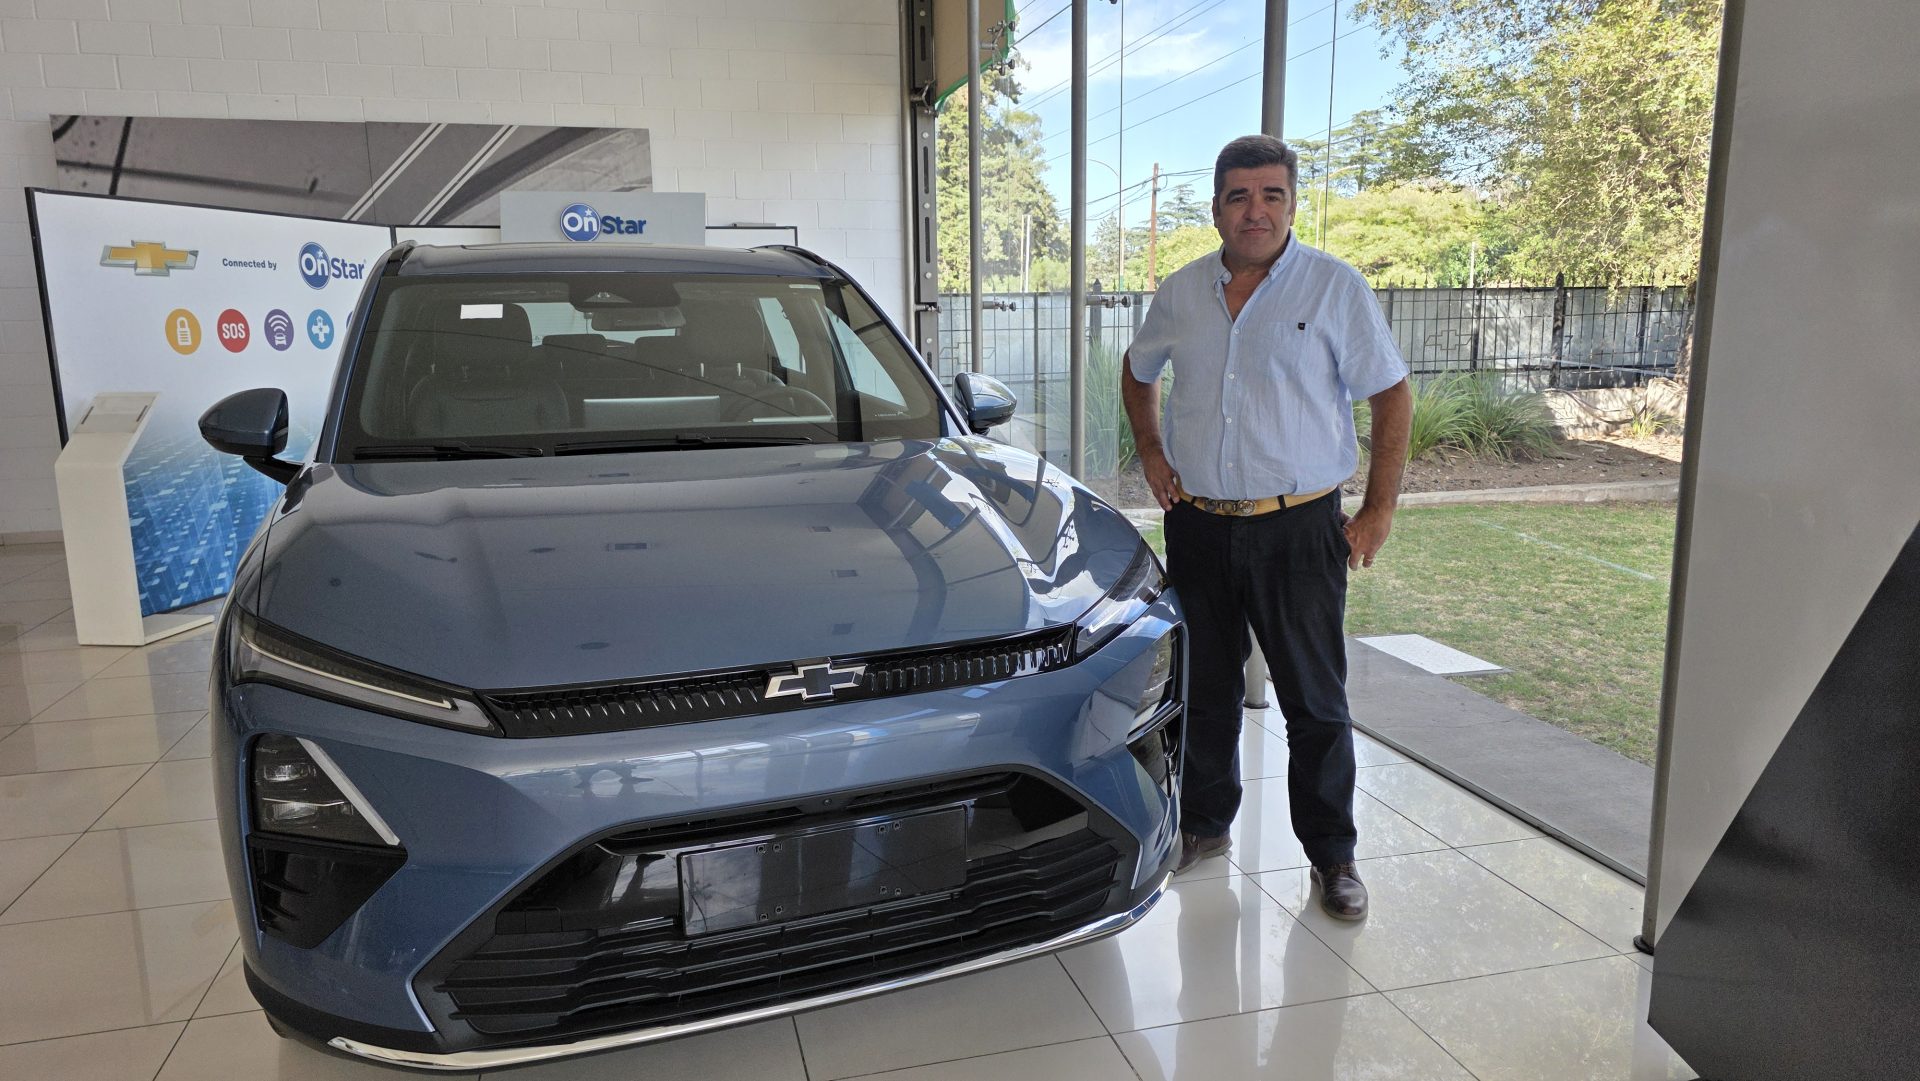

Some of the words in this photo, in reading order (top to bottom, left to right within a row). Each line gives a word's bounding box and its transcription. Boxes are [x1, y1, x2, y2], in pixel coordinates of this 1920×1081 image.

[562, 208, 646, 235] OnStar
[222, 258, 266, 269] Connected
[268, 262, 277, 271] by
[300, 250, 365, 280] OnStar
[222, 323, 246, 339] SOS
